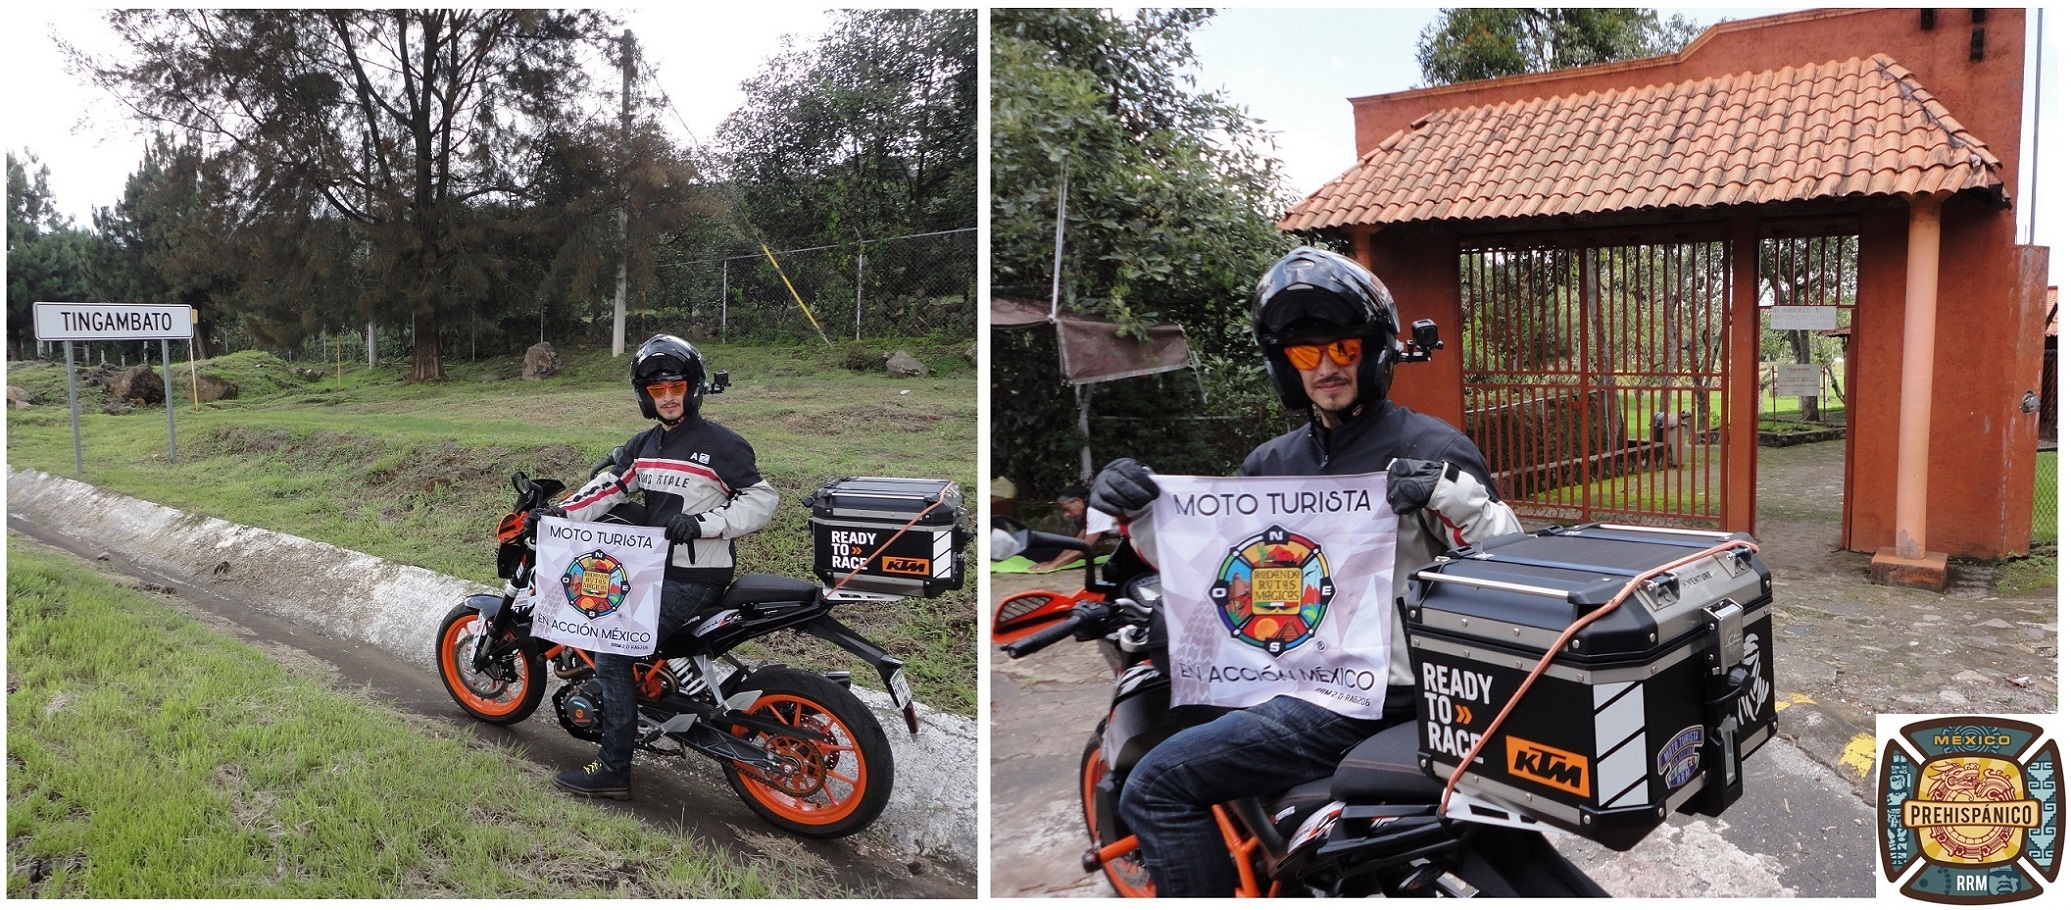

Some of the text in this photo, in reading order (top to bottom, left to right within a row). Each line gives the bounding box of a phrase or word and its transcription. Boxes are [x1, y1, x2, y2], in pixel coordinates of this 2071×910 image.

[60, 312, 172, 332] TINGAMBATO
[1173, 490, 1372, 516] MOTO TURISTA
[550, 526, 652, 548] MOTO TURISTA
[831, 531, 877, 545] READY
[1269, 531, 1283, 541] N
[831, 543, 850, 556] TO
[832, 555, 868, 570] RACE
[886, 559, 926, 572] KTM
[1212, 588, 1227, 598] O
[1322, 586, 1332, 596] E
[538, 614, 650, 642] EN ACCIÓN MÉXICO
[1269, 642, 1280, 652] S
[1180, 663, 1375, 690] EN ACCIÓN MÉXICO
[1422, 662, 1493, 704] READY
[1424, 692, 1452, 724] TO
[1427, 721, 1484, 764] RACE
[1514, 746, 1582, 788] KTM
